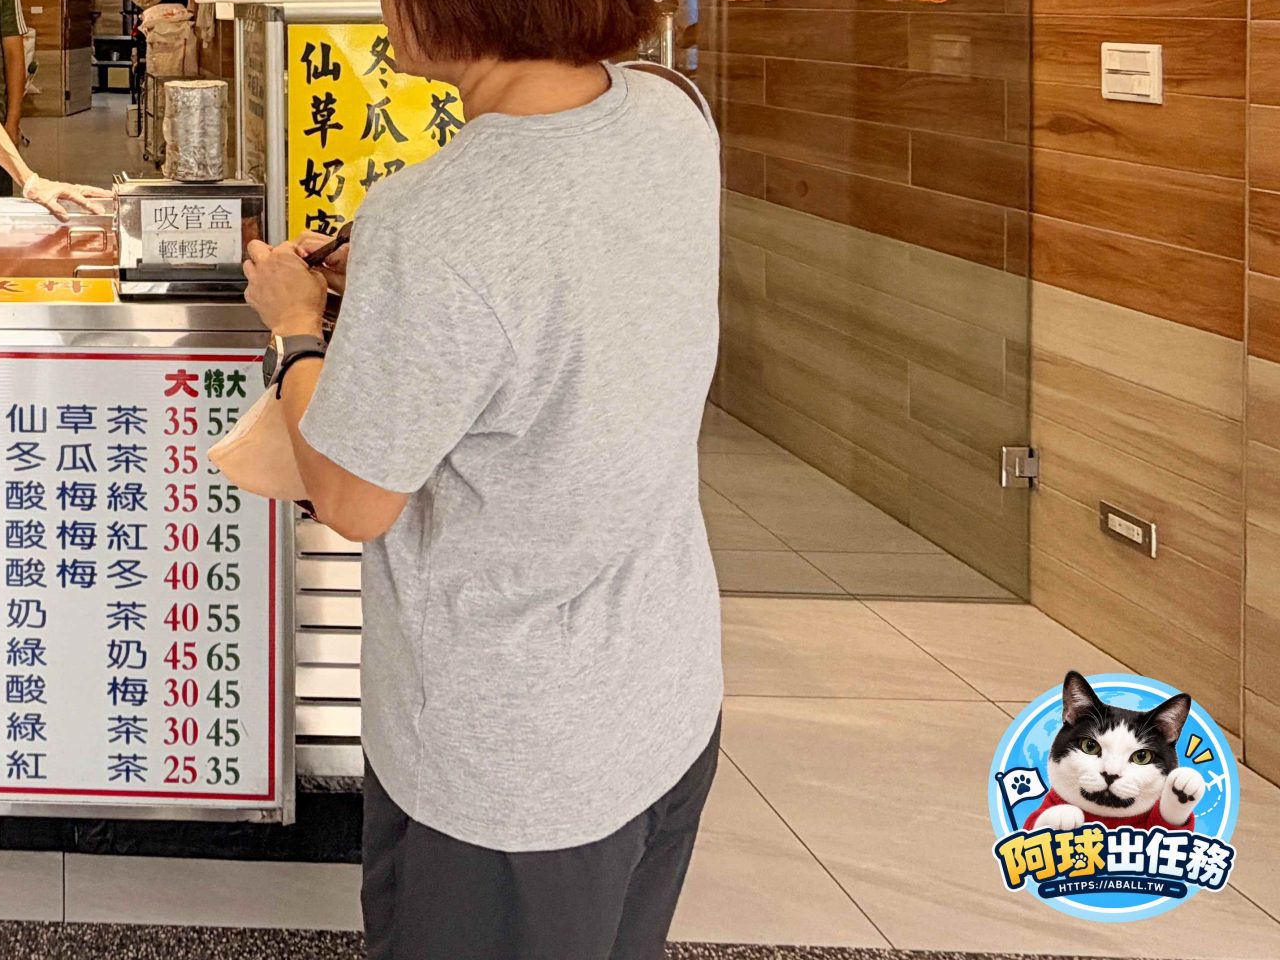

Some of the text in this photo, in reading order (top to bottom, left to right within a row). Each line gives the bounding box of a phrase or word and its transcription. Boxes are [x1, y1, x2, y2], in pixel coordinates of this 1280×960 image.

[154, 204, 233, 231] 吸管盒
[158, 240, 218, 259] 輕輕按
[164, 369, 246, 398] 大 特大
[6, 404, 148, 435] 仙草茶
[164, 407, 198, 435] 35
[6, 442, 148, 474] 冬瓜茶
[164, 445, 198, 474] 35
[6, 481, 241, 513] 酸梅綠 35 55
[6, 519, 240, 552] 酸梅紅 30 45
[6, 558, 240, 591] 酸梅冬 40 65
[164, 603, 198, 631] 40
[207, 604, 240, 632] 55
[164, 641, 197, 670] 45
[207, 643, 240, 671] 65
[164, 678, 198, 707] 30
[206, 680, 240, 708] 45
[164, 717, 198, 745] 30
[206, 718, 240, 747] 45
[164, 755, 197, 784] 25
[206, 757, 240, 785] 35
